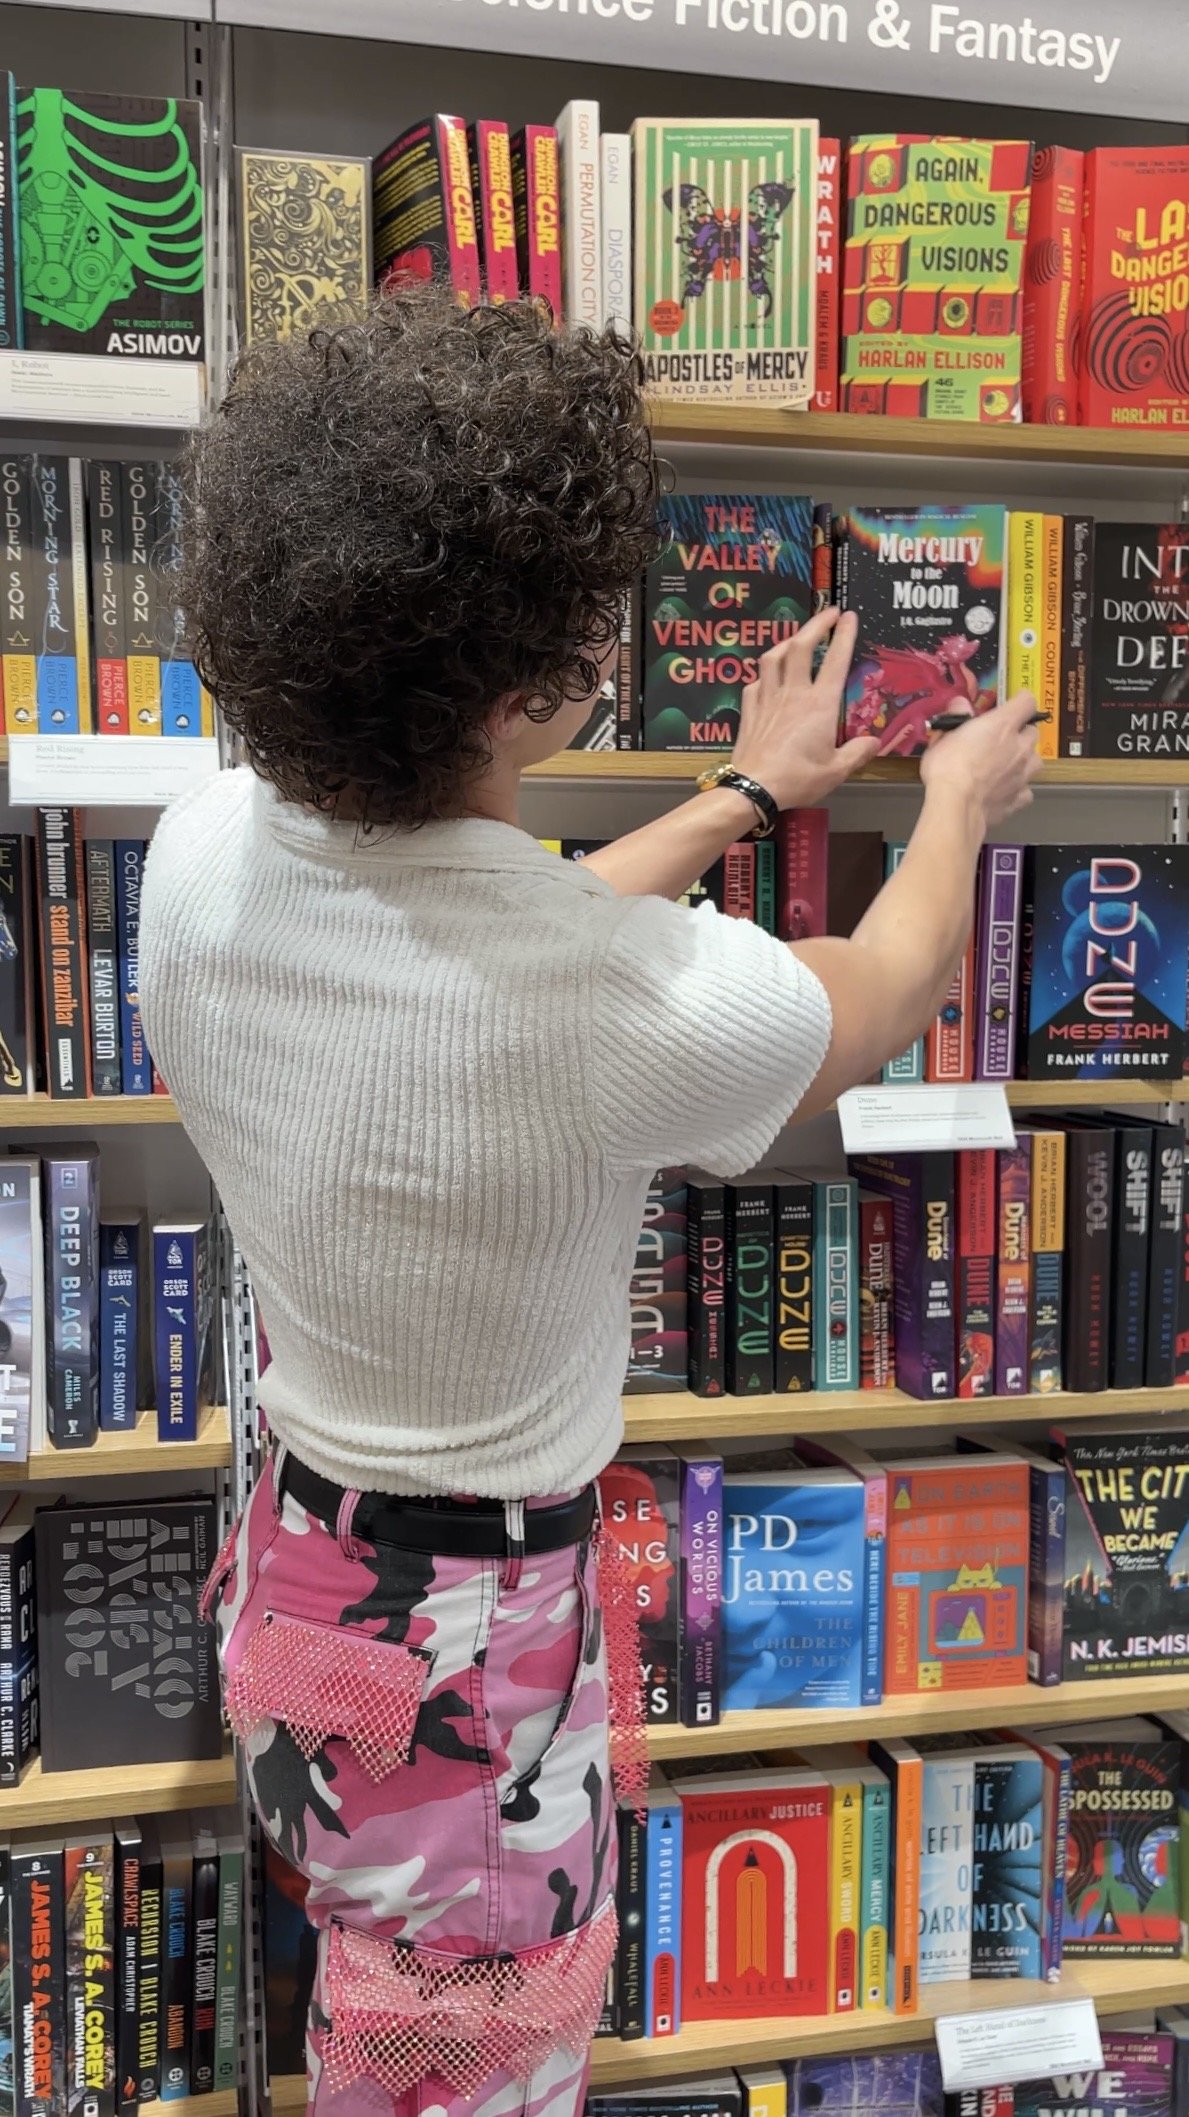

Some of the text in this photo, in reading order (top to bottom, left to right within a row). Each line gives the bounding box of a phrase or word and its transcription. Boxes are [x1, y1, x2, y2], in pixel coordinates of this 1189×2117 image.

[866, 0, 1121, 84] & Fantasy
[608, 147, 618, 184] EGAN
[916, 158, 983, 183] AGAIN,
[452, 187, 475, 250] CARL
[579, 113, 596, 279] EGAN PERMUTATION
[816, 155, 837, 275] WRATH
[864, 203, 996, 227] DANGEROUS
[491, 189, 514, 253] CARL
[536, 194, 557, 257] CARL
[1116, 226, 1133, 243] THE
[921, 246, 1009, 272] VISIONS
[107, 332, 201, 355] ASIMOV
[858, 351, 1006, 369] HARLAN ELLISON
[647, 352, 808, 382] APOSTLES OF MERCY
[654, 382, 799, 395] LINDSAY ELLIS
[1111, 408, 1167, 424] HARLAN
[40, 466, 61, 564] MORNING
[704, 505, 755, 532] THE
[2, 462, 25, 621] GOLDEN SON
[100, 470, 118, 626] RED RISING
[129, 467, 150, 622] GOLDEN SON
[677, 544, 781, 571] VALLEY
[878, 532, 983, 567] Mercury
[910, 566, 943, 581] to the
[1024, 518, 1034, 624] WILLIAM GIBSON
[1154, 585, 1180, 595] THE
[708, 582, 750, 609] OF
[892, 581, 959, 609] Moon
[1045, 528, 1058, 685] WILLIAM GIBSON COUNT
[620, 646, 631, 722] LIGHT VEIL
[1021, 654, 1029, 671] THE
[103, 663, 112, 708] BROWN
[115, 665, 125, 706] PIERCE
[689, 722, 732, 742] KIM
[39, 807, 78, 1027] john brunner stand zanzibar
[1084, 857, 1142, 1018] DUNE
[89, 850, 115, 1060] AFTERMATH LEVAR BURTON
[124, 850, 143, 1066] OCTAVIA BUTLER SEED
[1048, 1023, 1169, 1040] MESSIAH
[1047, 1052, 1170, 1066] FRANK HERBERT
[1086, 1150, 1108, 1238] WOOL
[1125, 1149, 1148, 1236] SHIFT
[1159, 1147, 1182, 1234] SHIFT
[926, 1201, 948, 1261] Dune
[1005, 1202, 1025, 1260] Dune
[60, 1206, 82, 1351] DEEP BLACK
[702, 1237, 723, 1306] DUNE
[869, 1243, 883, 1289] DUNE
[737, 1245, 770, 1355] DUNE
[779, 1249, 811, 1351] DUNE
[113, 1313, 126, 1421] THE LAST SHADOW
[169, 1334, 183, 1424] ENDER IN EXILE
[836, 1340, 846, 1377] HOUSE
[65, 1369, 73, 1410] CAMERON
[73, 1376, 82, 1403] MILES
[1073, 1447, 1093, 1460] The
[1075, 1467, 1134, 1503] THE
[728, 1514, 798, 1551] PD
[1120, 1505, 1159, 1530] WE
[692, 1521, 704, 1595] WORLDS
[706, 1511, 719, 1601] ON VICIOUS
[1103, 1531, 1179, 1553] BECAME
[721, 1555, 854, 1604] James
[150, 1518, 194, 1719] ODYSSEY
[816, 1618, 853, 1631] THE
[896, 1593, 908, 1674] EMILY JANE
[752, 1635, 853, 1650] CHILDREN
[778, 1655, 853, 1669] OF MEN
[1070, 1638, 1119, 1660] N. K.
[0, 1624, 14, 1757] RAMA ARTHUR CLARKE
[198, 1649, 209, 1703] ARTHUR
[952, 1783, 994, 1812] THE
[1098, 1770, 1122, 1786] THE
[687, 1802, 823, 1823] ANCILLARY JUSTICE
[85, 1852, 94, 1863] 9
[974, 1822, 1034, 1851] HAND
[31, 1861, 41, 1871] 8
[840, 1817, 852, 1922] ANCILLARY SWORD
[870, 1814, 884, 1922] ANCILLARY MERCY
[957, 1863, 984, 1892] OF
[222, 1881, 239, 1926] WAYWARD
[658, 1837, 673, 1945] PROVENANCE
[31, 1879, 51, 1959] JAMES
[123, 1858, 139, 2013] CRAWLSPACE ADAM CHRISTOPHER
[626, 1826, 639, 2007] DANIEL KRAUS WHALEFALL
[31, 1963, 51, 1987] S.
[84, 1871, 104, 2090] JAMES S. A. COREY
[138, 1888, 160, 2069] RECURSION BLAKE CROUCH
[196, 1918, 217, 2002] BLAKE CROUCH
[32, 1991, 51, 2016] A.
[692, 1979, 816, 1999] ANN LECKIE
[75, 1997, 85, 2089] LEVIATHAN FALLS
[167, 2004, 185, 2049] ABANDON
[24, 2059, 35, 2099] WRATH
[33, 2021, 52, 2099] COREY
[1050, 2071, 1127, 2099] WE
